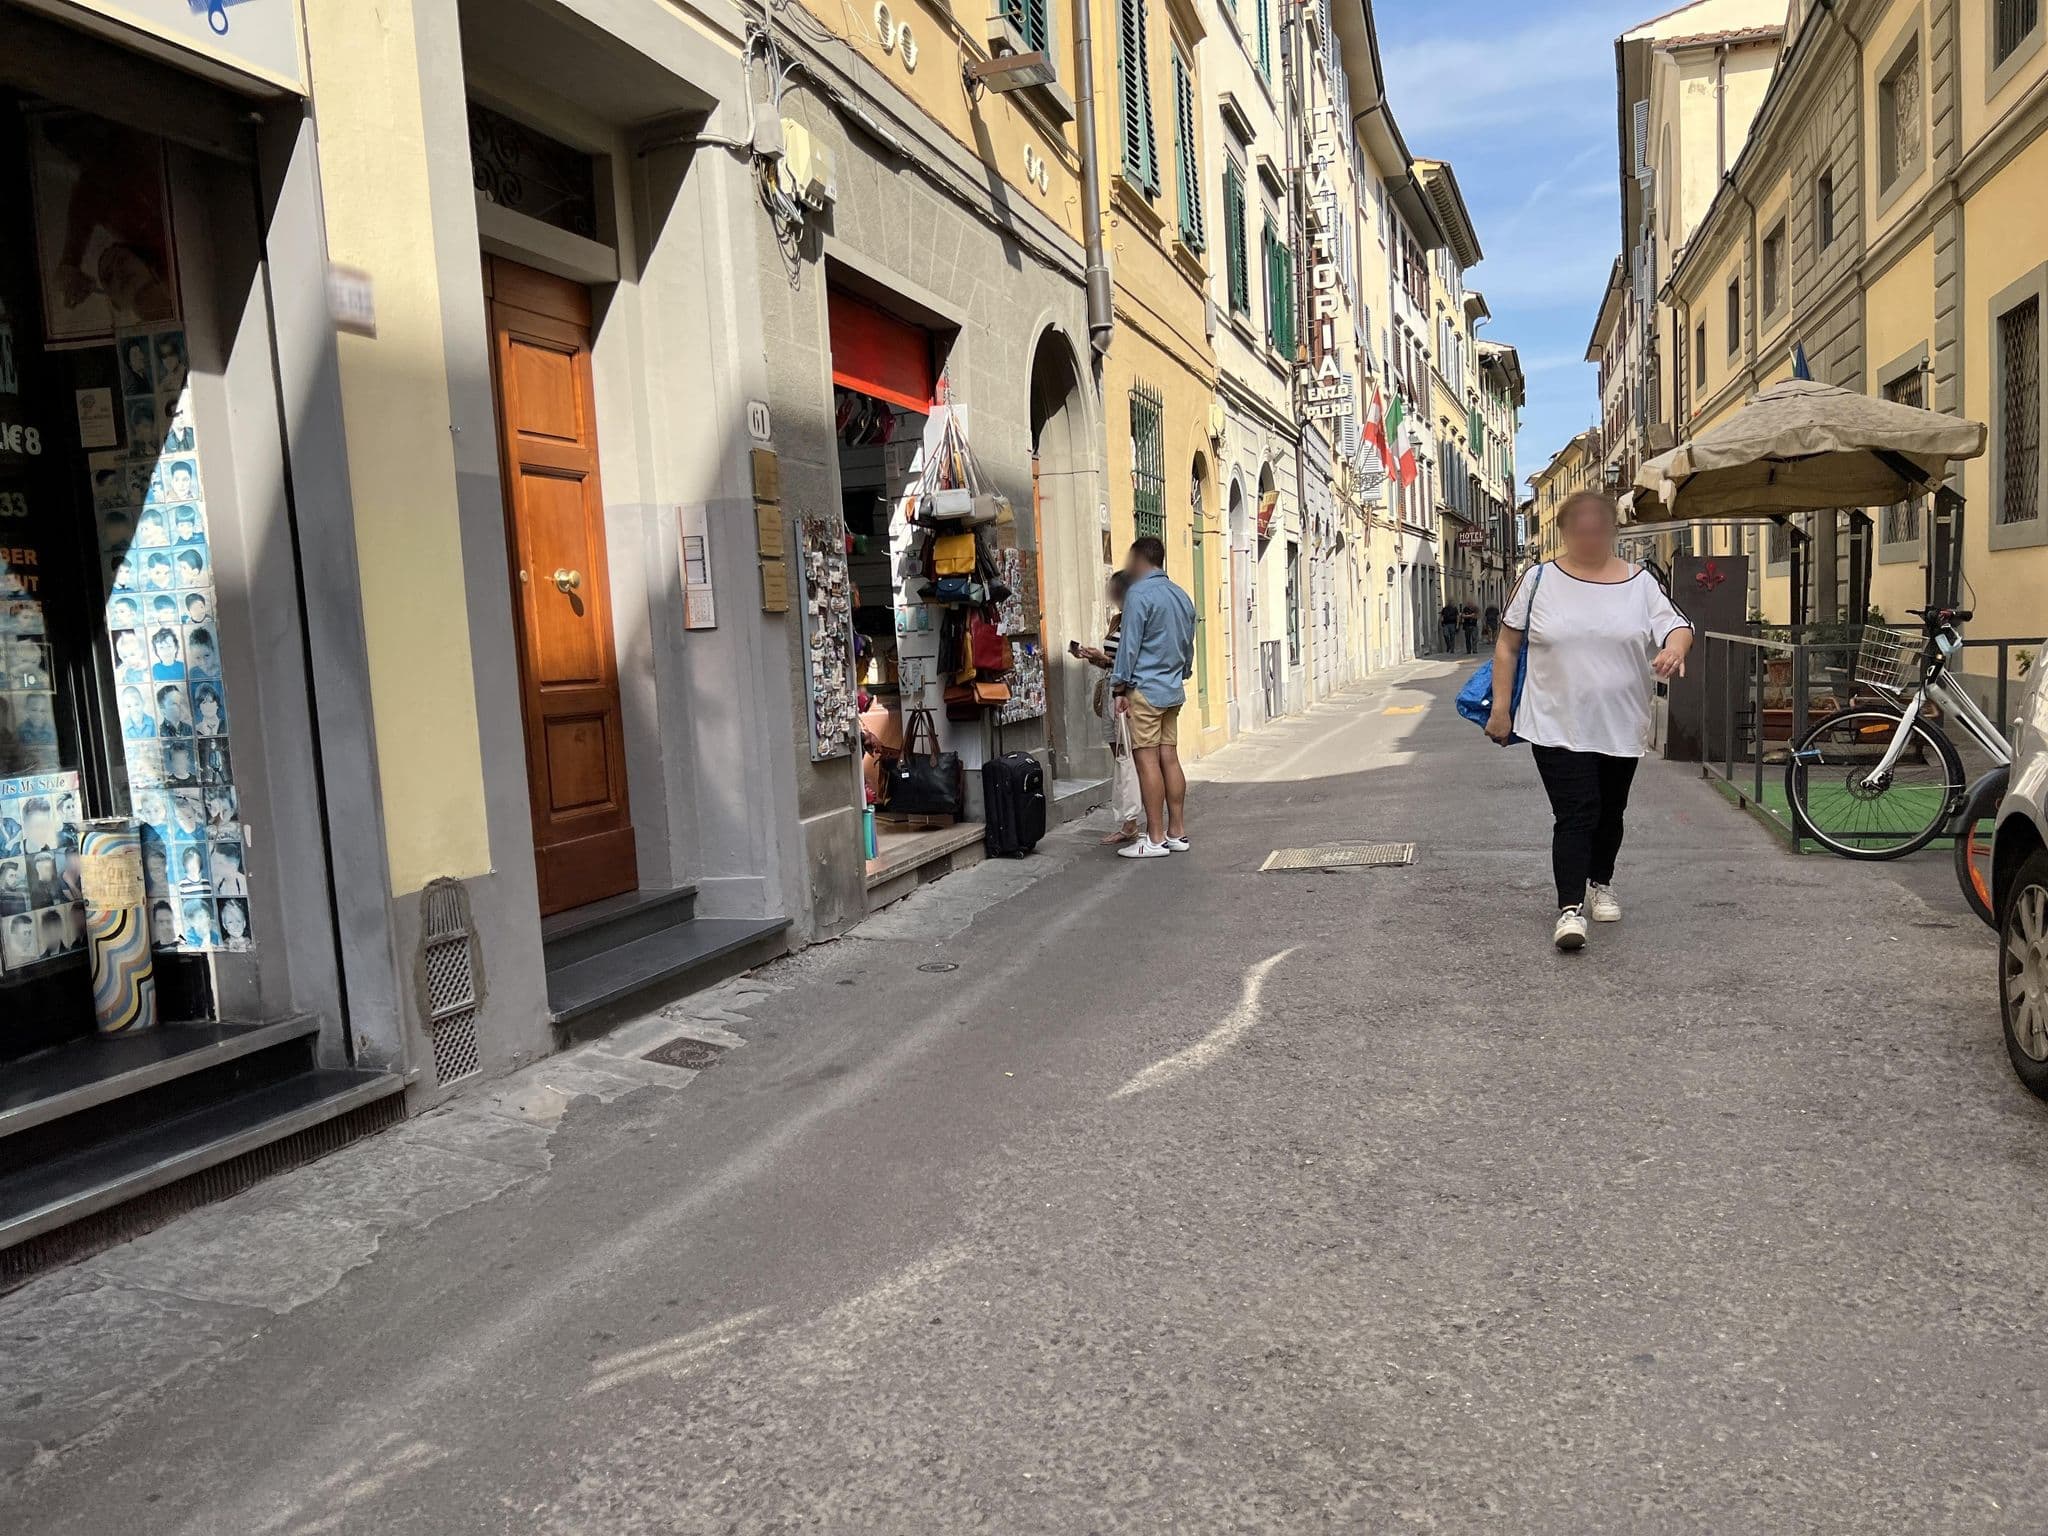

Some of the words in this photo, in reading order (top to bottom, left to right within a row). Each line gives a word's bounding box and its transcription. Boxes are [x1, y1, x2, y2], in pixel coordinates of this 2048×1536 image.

[1312, 104, 1340, 381] TRATTORIA
[1308, 384, 1349, 401] ENZO
[1306, 402, 1353, 420] PIERO
[752, 408, 766, 434] 61
[1460, 531, 1484, 539] HOTEL
[20, 780, 35, 793] My
